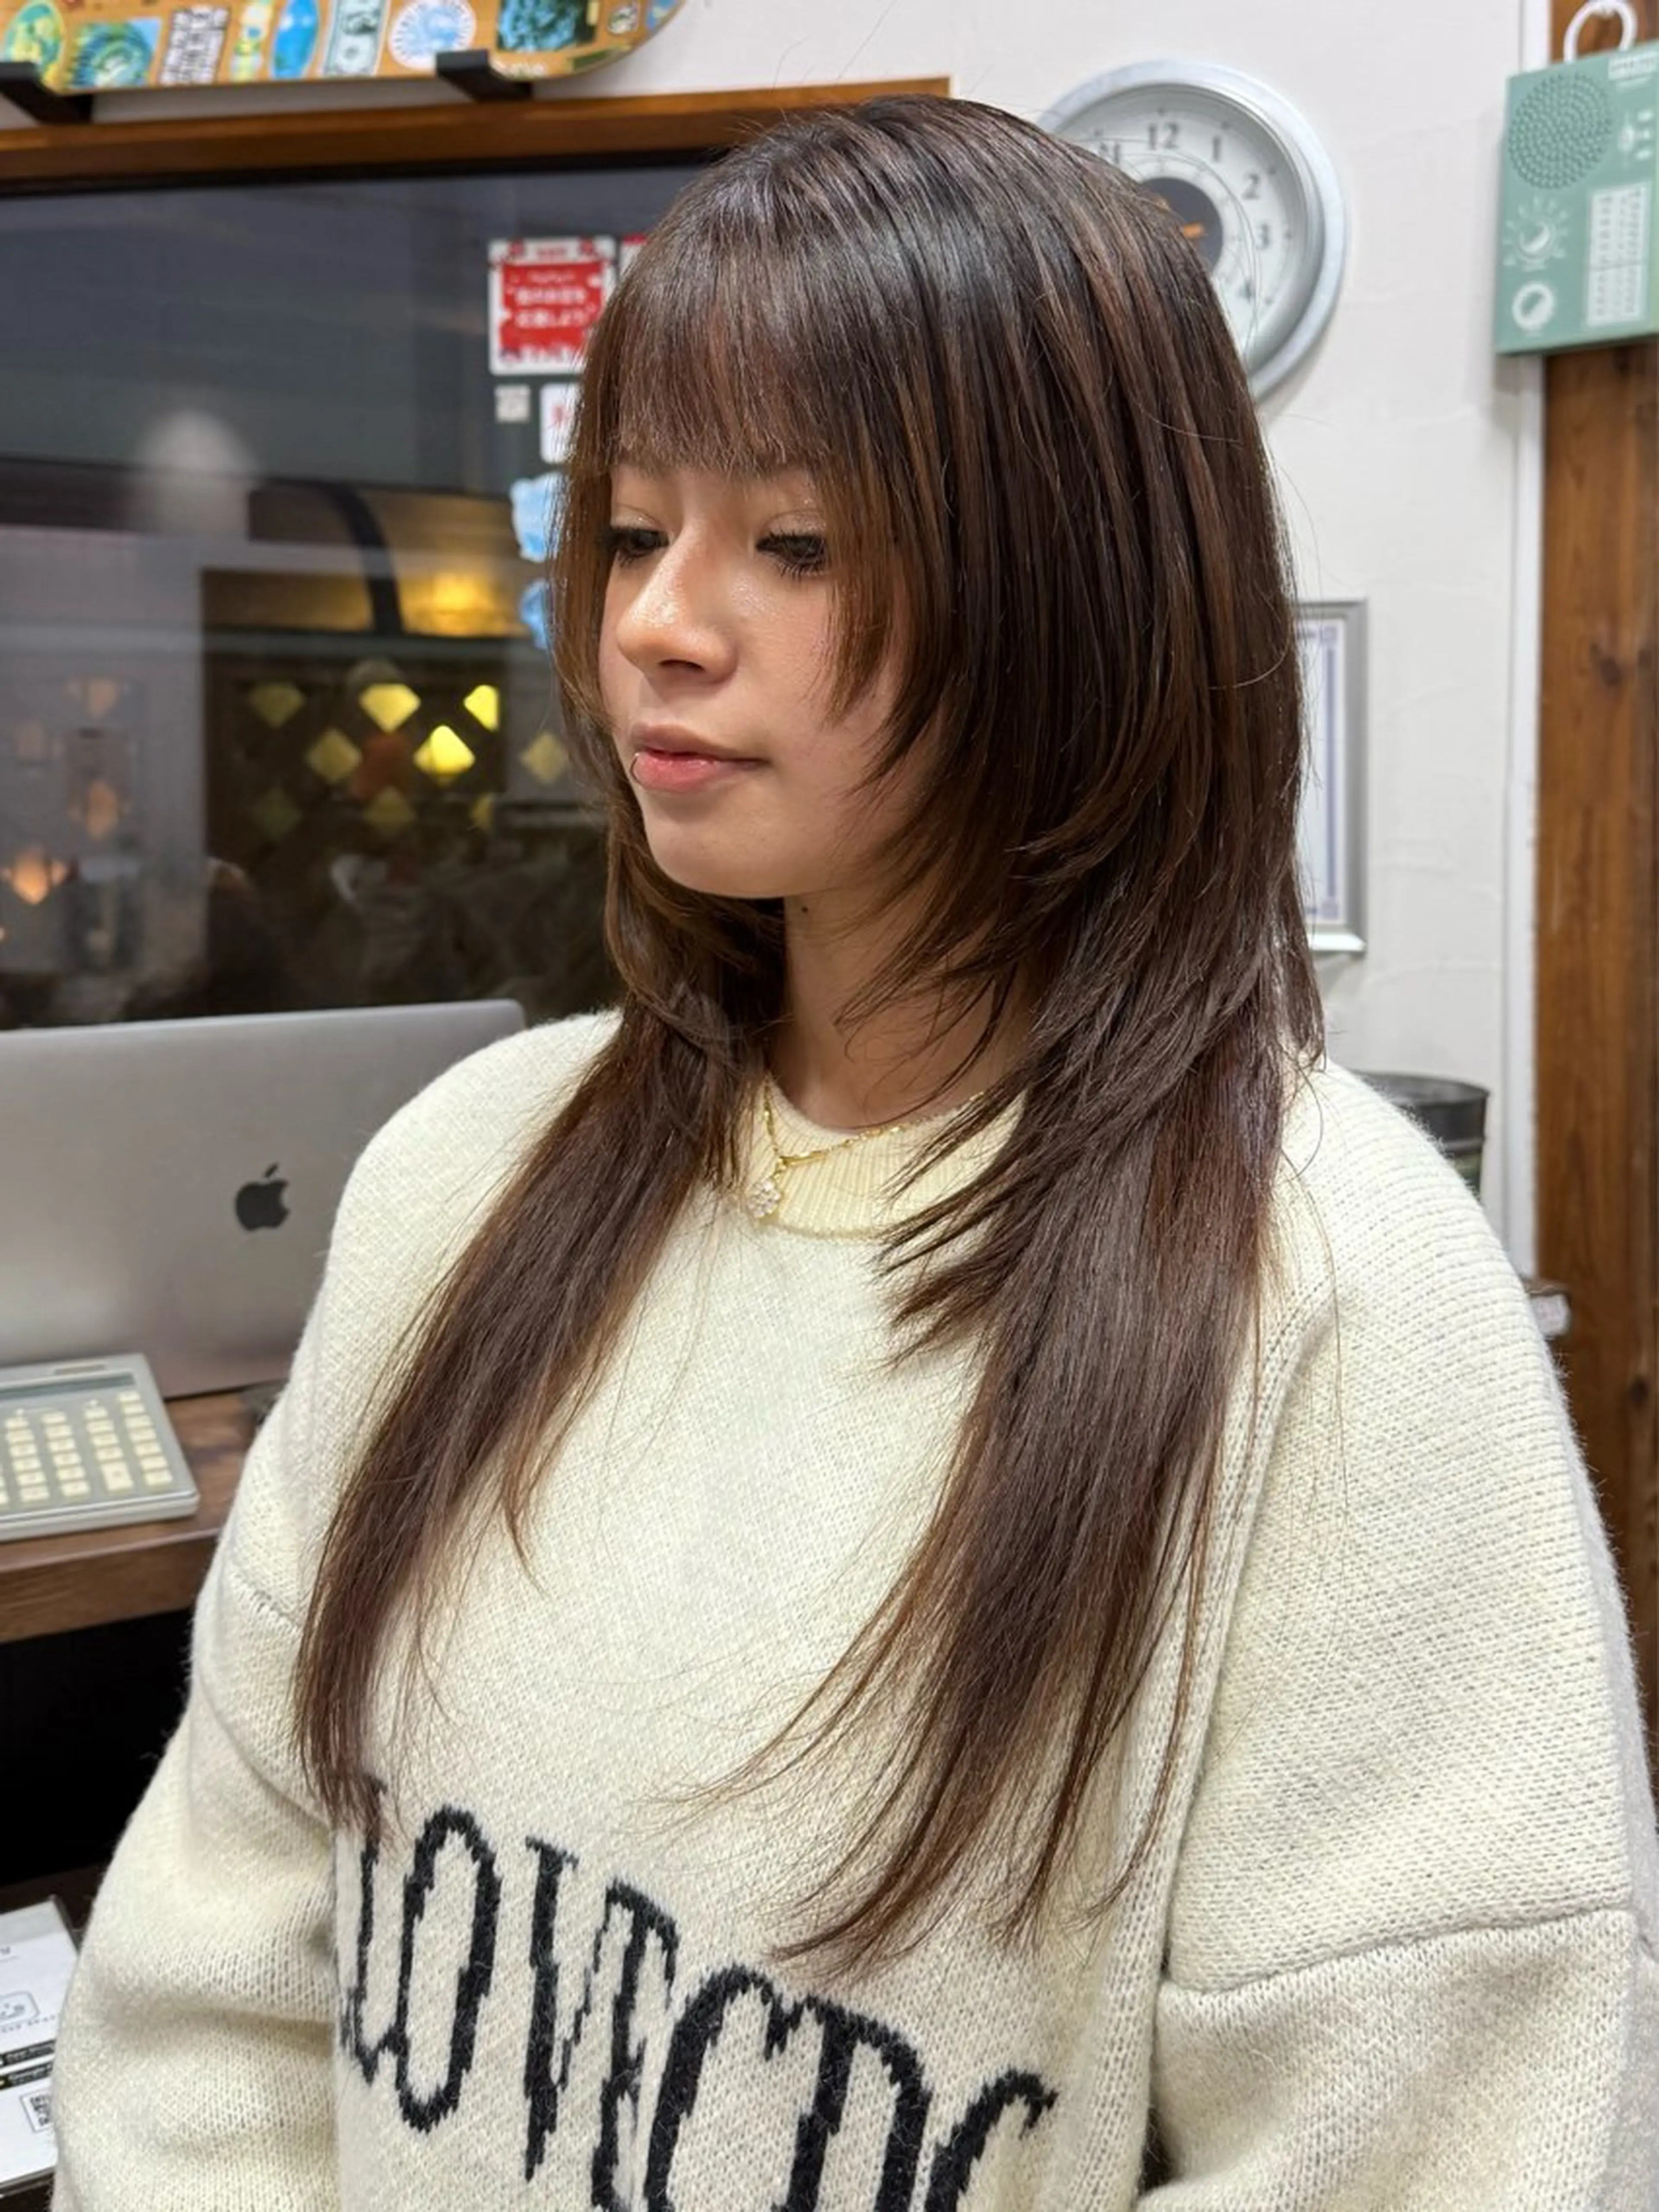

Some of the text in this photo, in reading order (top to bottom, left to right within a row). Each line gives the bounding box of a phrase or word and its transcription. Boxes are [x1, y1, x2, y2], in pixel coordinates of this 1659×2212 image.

[1148, 122, 1179, 150] 12
[1212, 135, 1221, 162] 1
[1241, 173, 1260, 199] 2
[1257, 222, 1271, 249] 3
